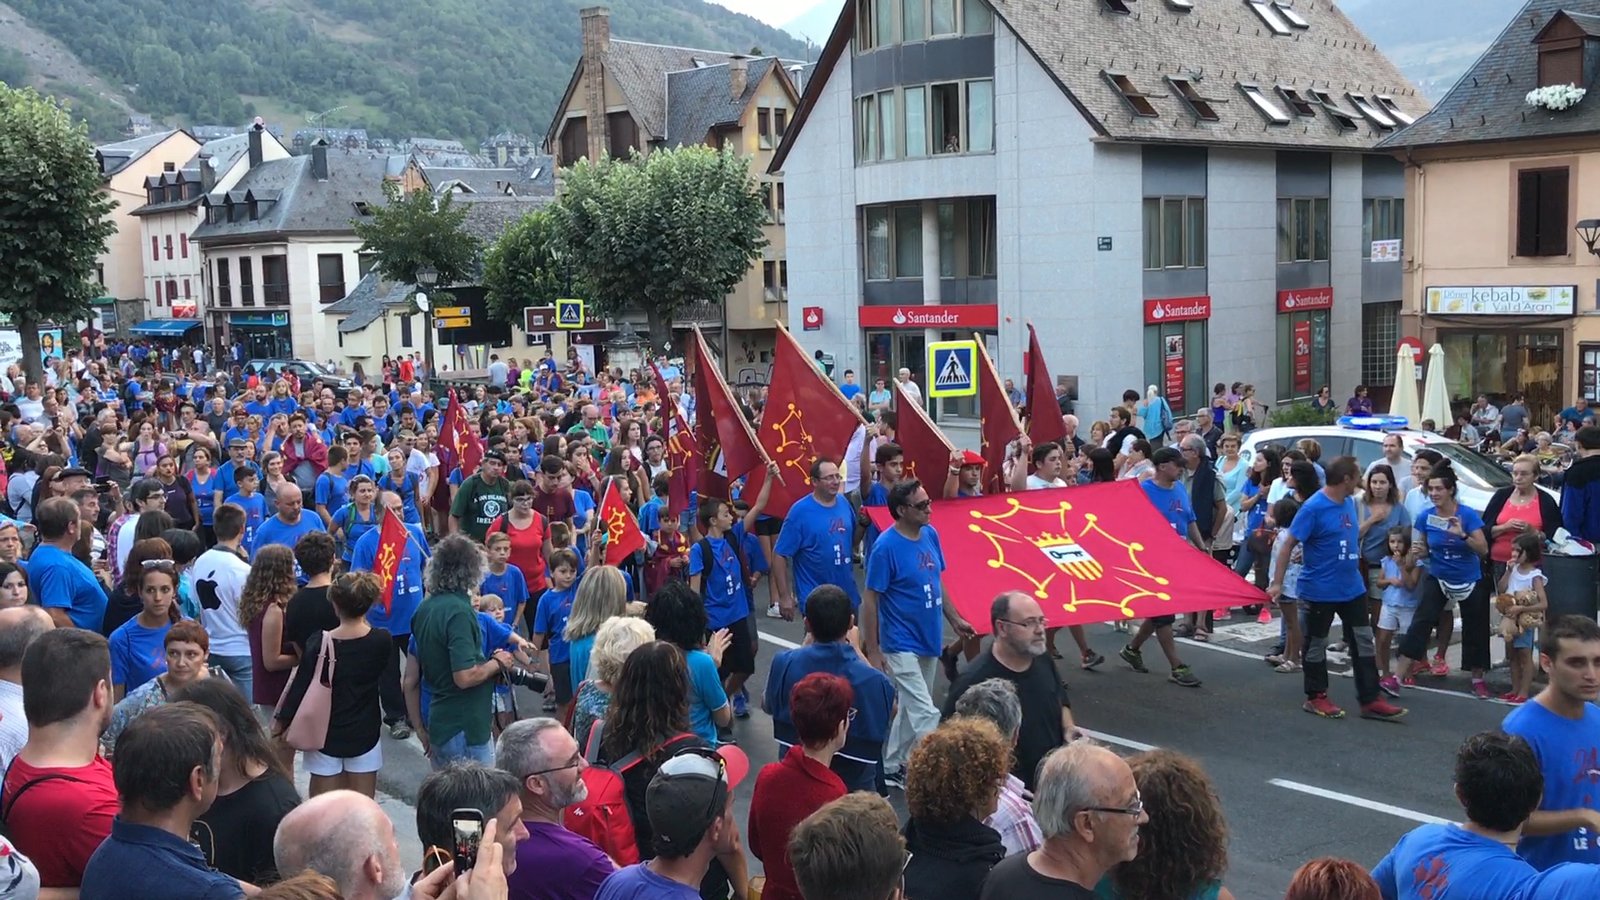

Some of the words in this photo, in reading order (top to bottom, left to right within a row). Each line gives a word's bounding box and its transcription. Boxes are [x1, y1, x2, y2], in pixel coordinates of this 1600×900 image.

[1295, 292, 1330, 307] Santander
[1472, 287, 1521, 302] kebab
[1165, 301, 1207, 317] Santander
[907, 310, 959, 324] Santander
[1573, 837, 1588, 850] LE
